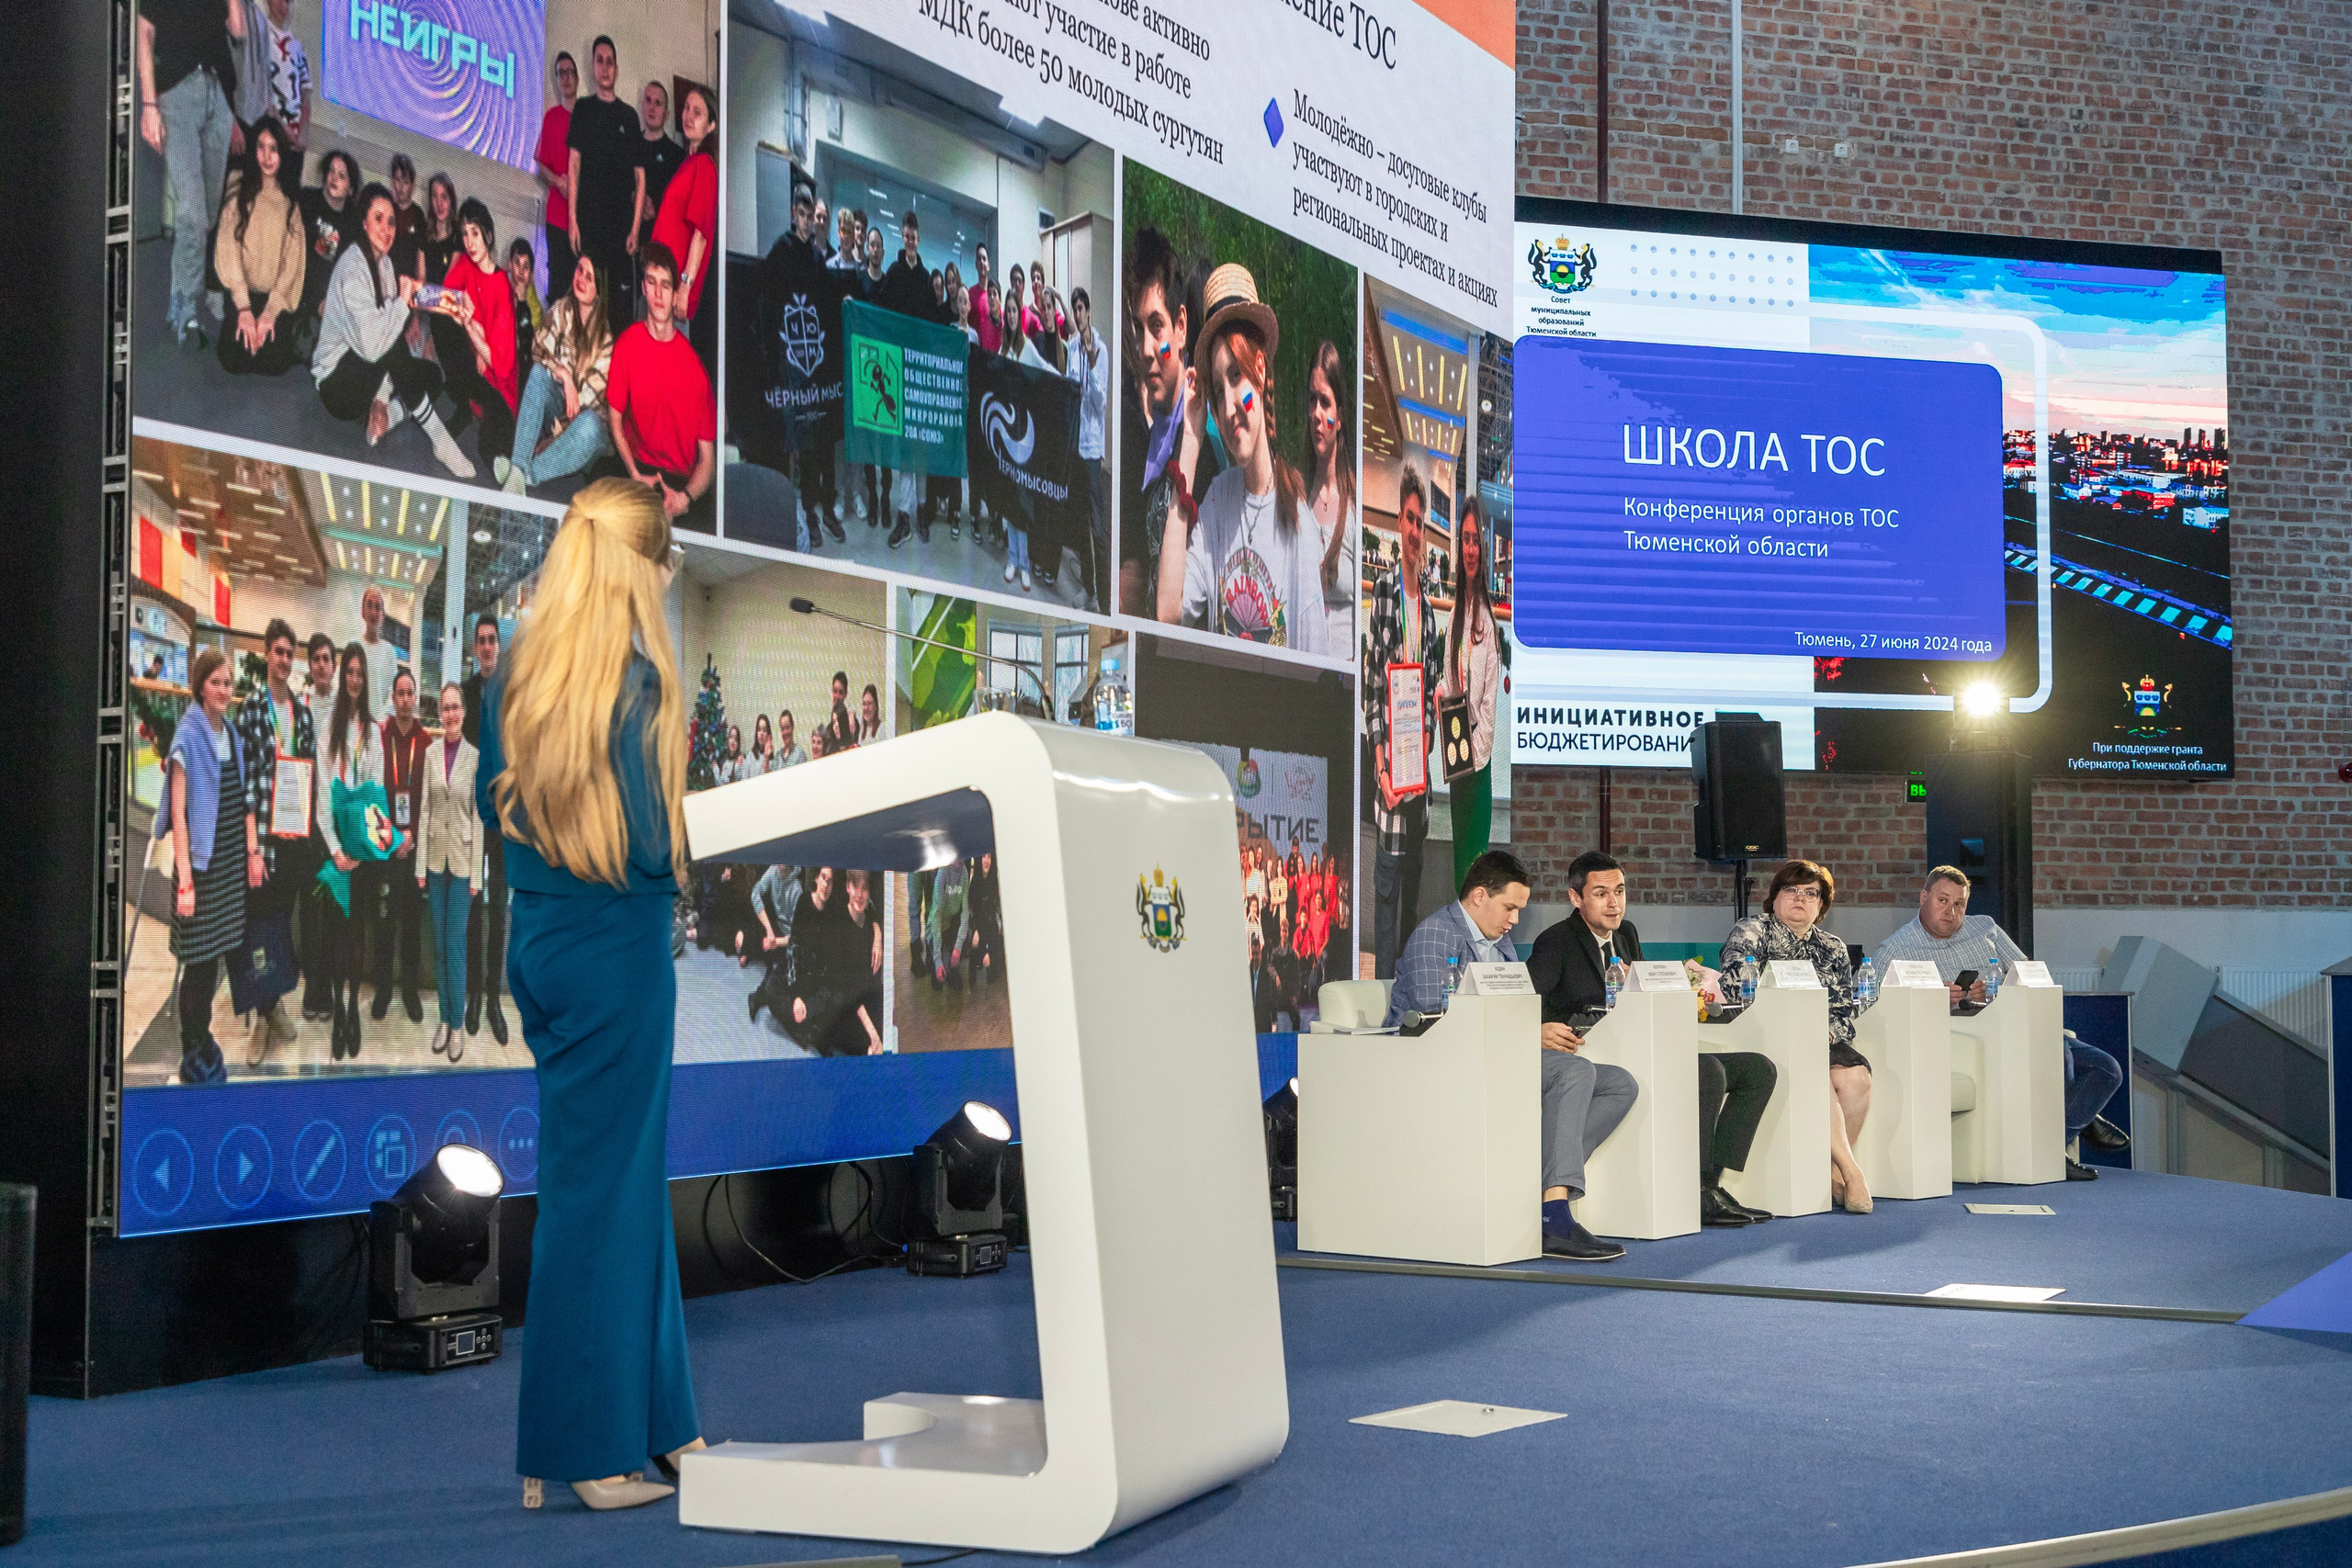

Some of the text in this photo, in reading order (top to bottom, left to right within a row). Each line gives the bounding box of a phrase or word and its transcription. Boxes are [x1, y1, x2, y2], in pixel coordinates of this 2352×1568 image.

[1143, 6, 1210, 61] активно
[1350, 1, 1396, 70] ТОС
[1045, 1, 1117, 59] участие
[1121, 42, 1131, 67] в
[1135, 50, 1192, 99] работе
[978, 10, 1035, 69] более
[1039, 48, 1063, 85] 50
[1068, 65, 1149, 128] молодых
[1152, 109, 1224, 165] сургутян
[1294, 88, 1374, 159] Молодёжно
[1387, 151, 1450, 202] досуговые
[1452, 187, 1487, 223] клубы
[1293, 141, 1449, 243] участвуют в городских и
[1293, 186, 1498, 308] региональных проектах и акциях
[1531, 306, 1591, 317] муниципальных
[1550, 296, 1571, 304] Совет
[1526, 325, 1597, 337] Тюменской области
[1538, 317, 1585, 326] образований
[764, 380, 843, 408] ЧЁРНЫЙ МЫС
[1623, 424, 1885, 477] ШКОЛА ТОС
[1623, 497, 1900, 528] Конференция органов ТОС
[1623, 530, 1829, 558] Тюменской области
[1794, 632, 1992, 654] Тюмень, 27 июня 2024 года
[1517, 707, 1704, 728] ИНИЦИАТИВНОЕ
[1517, 732, 1692, 752] БЮДЖЕТИРОВАНИ
[2092, 742, 2203, 756] При поддержке гранта
[2068, 758, 2227, 772] Губернатора Тюменской области
